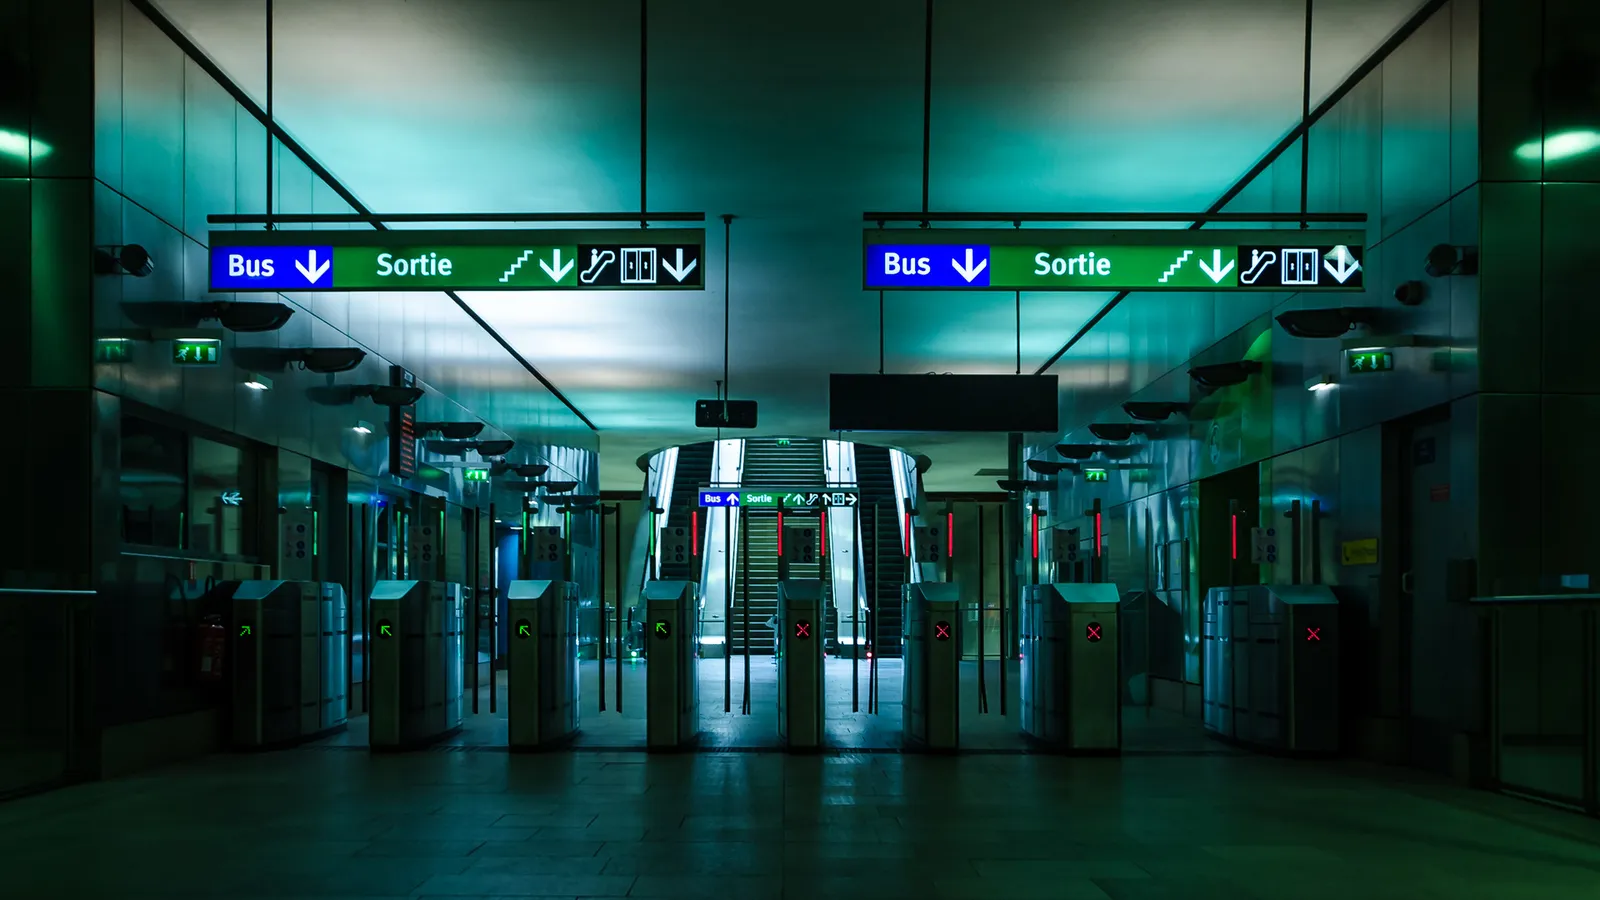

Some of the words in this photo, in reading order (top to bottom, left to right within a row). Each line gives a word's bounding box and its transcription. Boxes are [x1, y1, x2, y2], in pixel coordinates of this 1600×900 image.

[229, 254, 275, 277] Bus
[376, 252, 453, 276] Sortie
[884, 253, 931, 276] Bus
[1034, 252, 1111, 276] Sortie
[705, 494, 721, 503] Bus
[746, 494, 772, 503] Sortie
